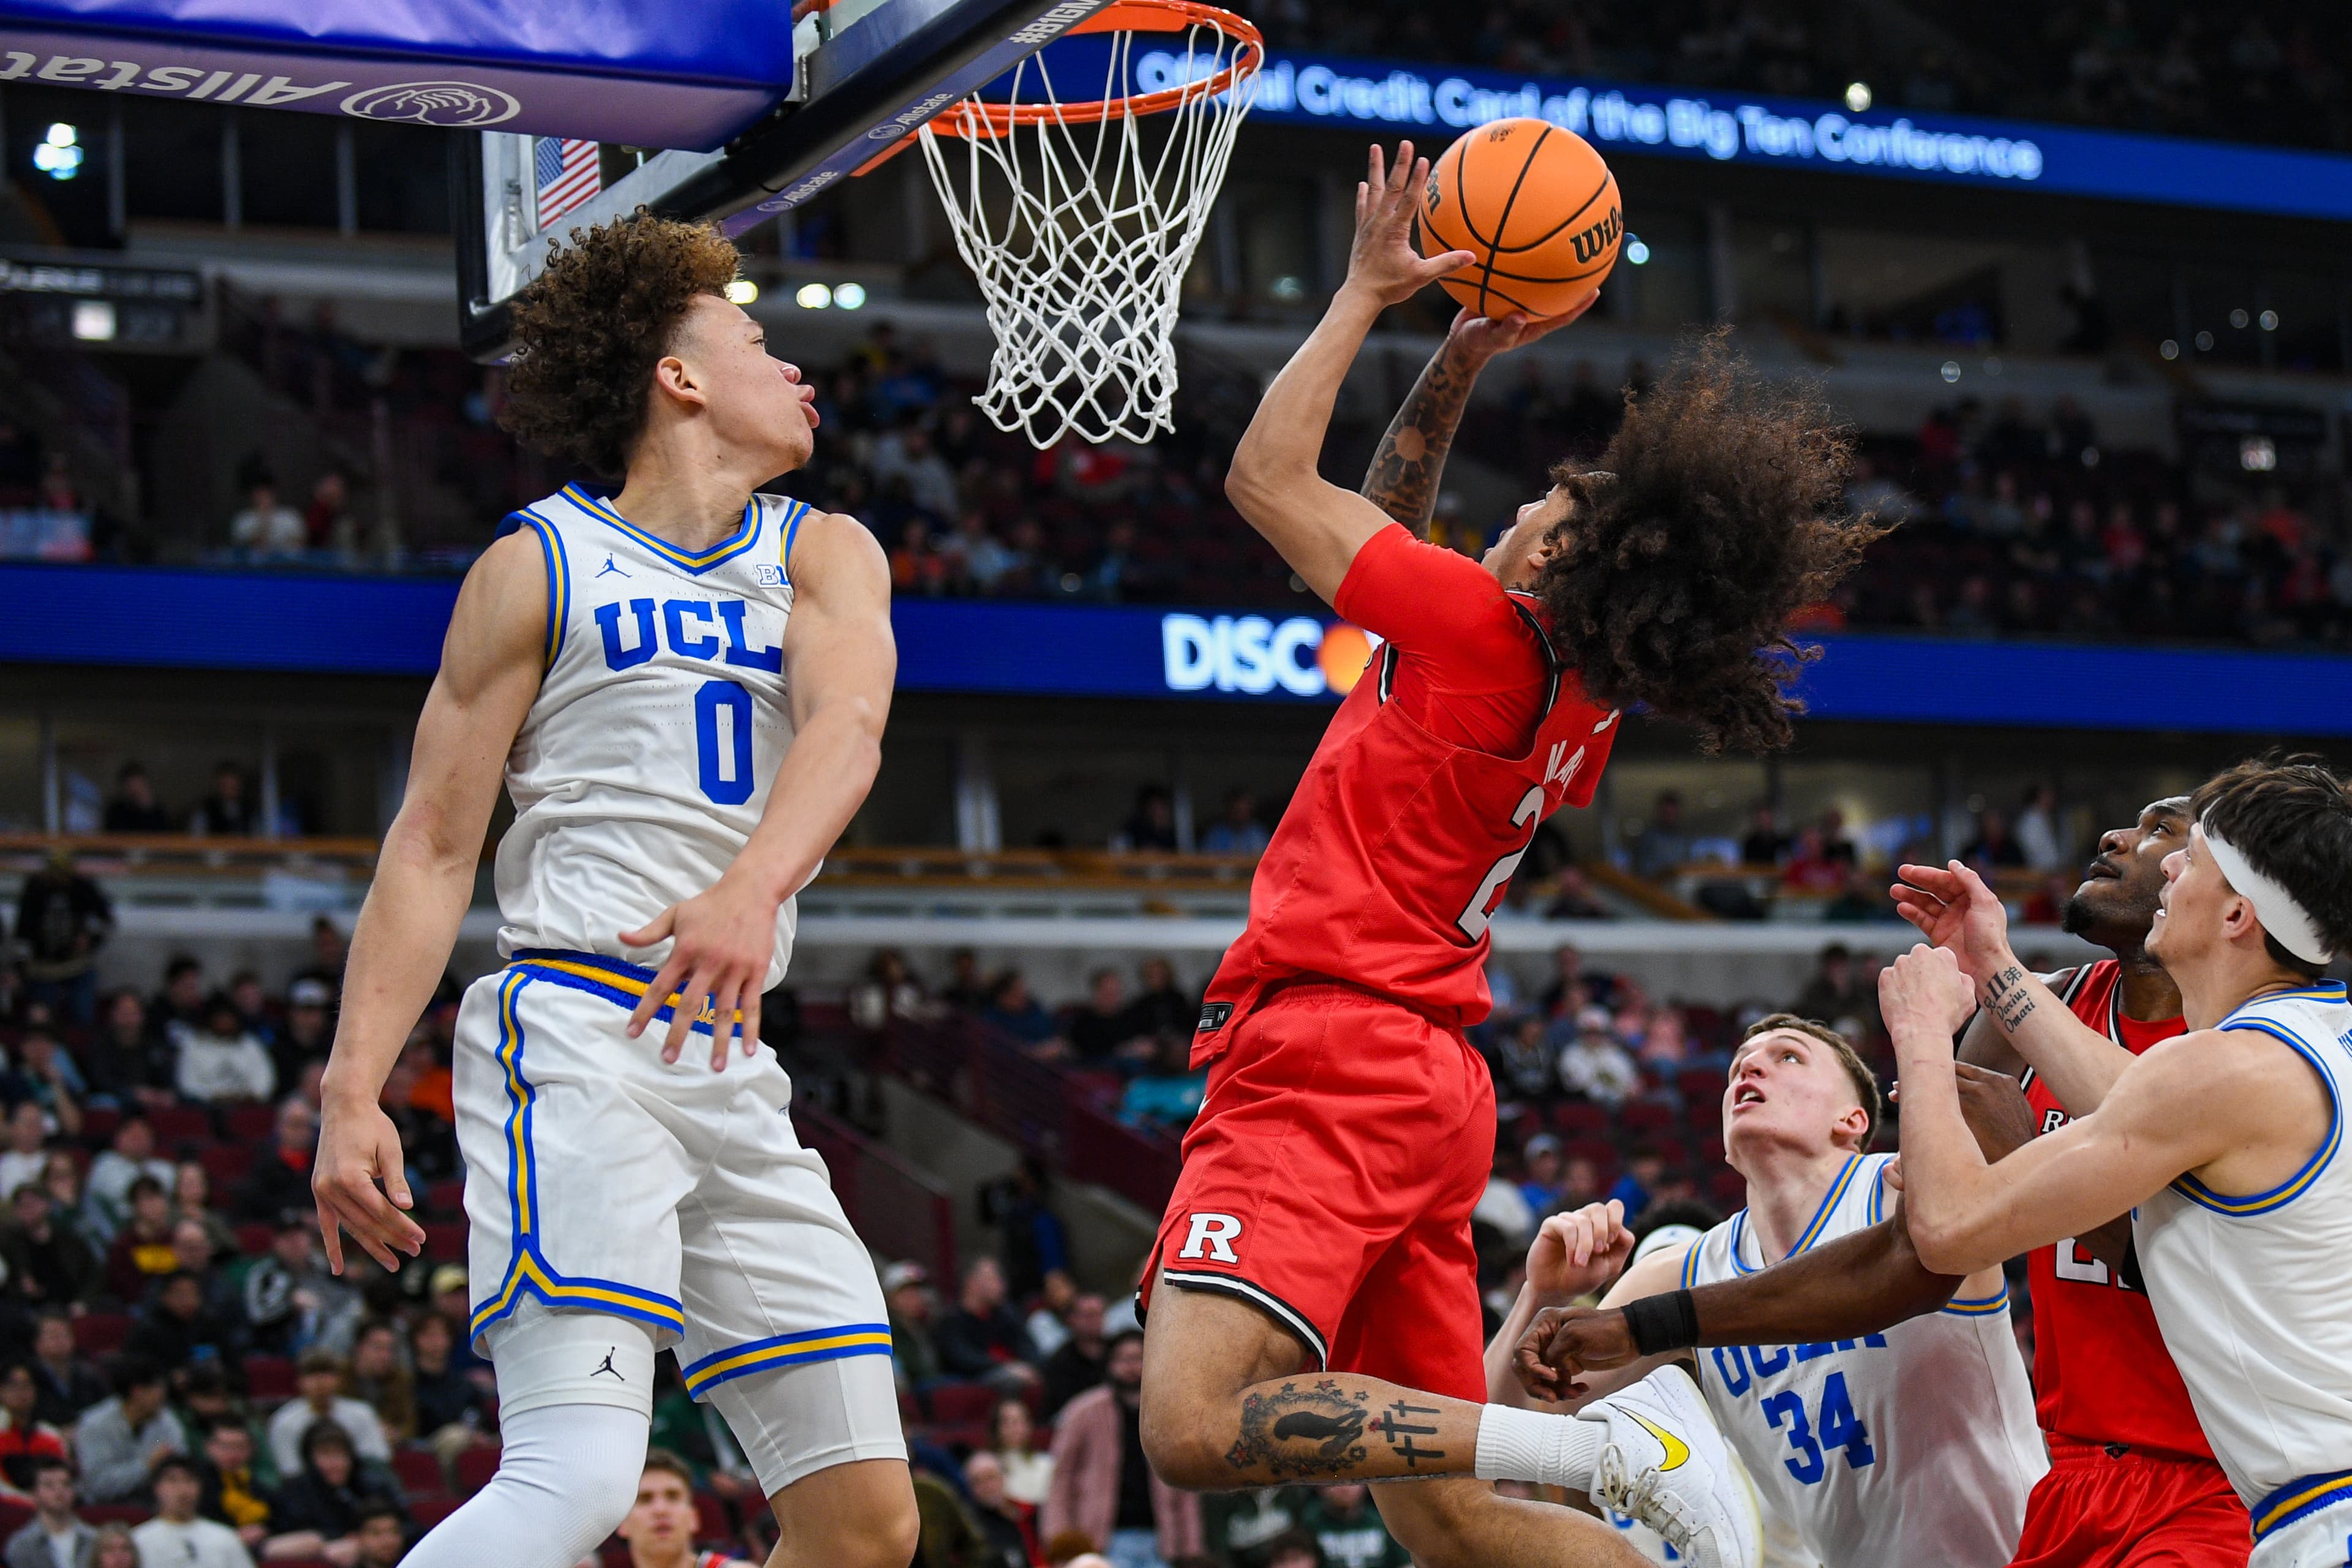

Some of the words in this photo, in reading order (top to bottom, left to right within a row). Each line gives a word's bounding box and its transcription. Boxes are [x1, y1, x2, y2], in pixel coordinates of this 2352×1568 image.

[895, 93, 953, 126] Allstate
[1296, 65, 1435, 124] Credit
[1434, 77, 1541, 127] Card
[1541, 86, 1591, 137] of
[1591, 90, 1666, 144] the
[1665, 99, 1739, 160] Big
[1735, 105, 1815, 158] Ten
[1814, 113, 2043, 180] Conference
[783, 170, 838, 203] Allstate
[695, 680, 755, 805] 0
[1997, 988, 2027, 1021] Darius
[2005, 997, 2035, 1033] Omari
[1178, 1213, 1243, 1264] R
[1760, 1371, 1874, 1485] 34
